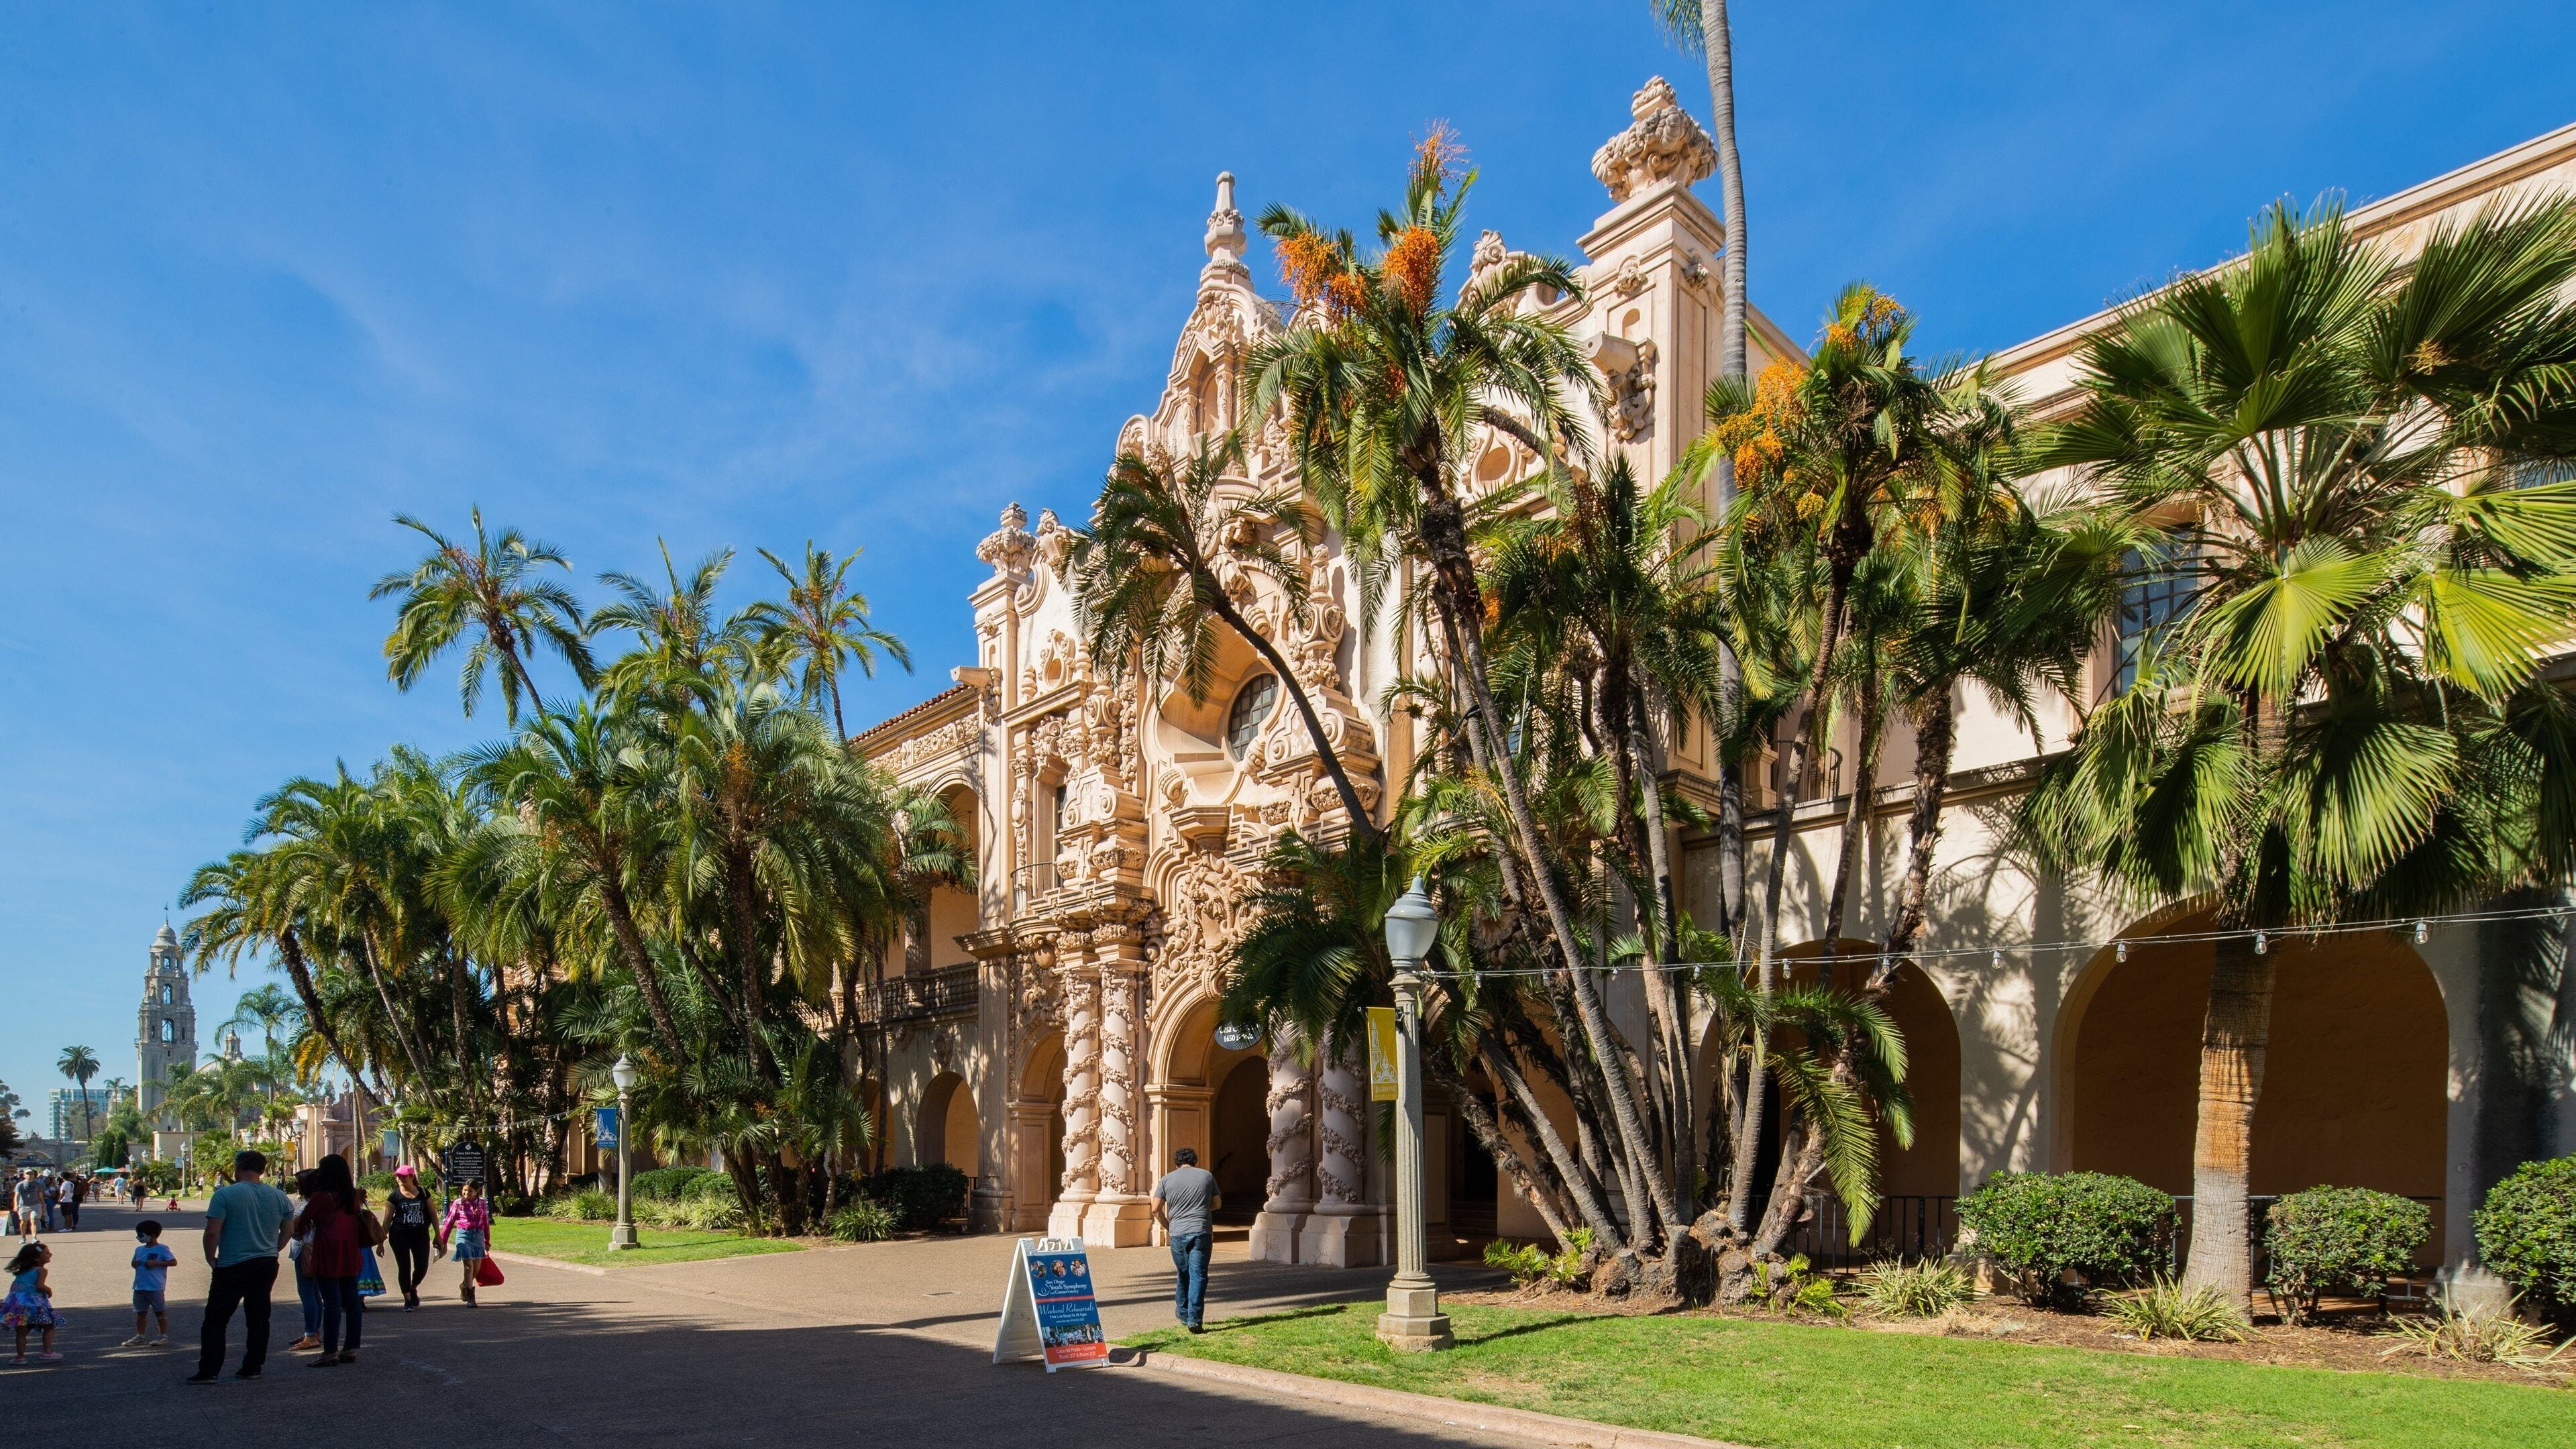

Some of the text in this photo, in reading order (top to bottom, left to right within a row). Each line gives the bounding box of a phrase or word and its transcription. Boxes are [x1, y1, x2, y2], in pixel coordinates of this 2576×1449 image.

[407, 1214, 421, 1223] GOOD
[1038, 1302, 1094, 1315] Weekend Rehearsals
